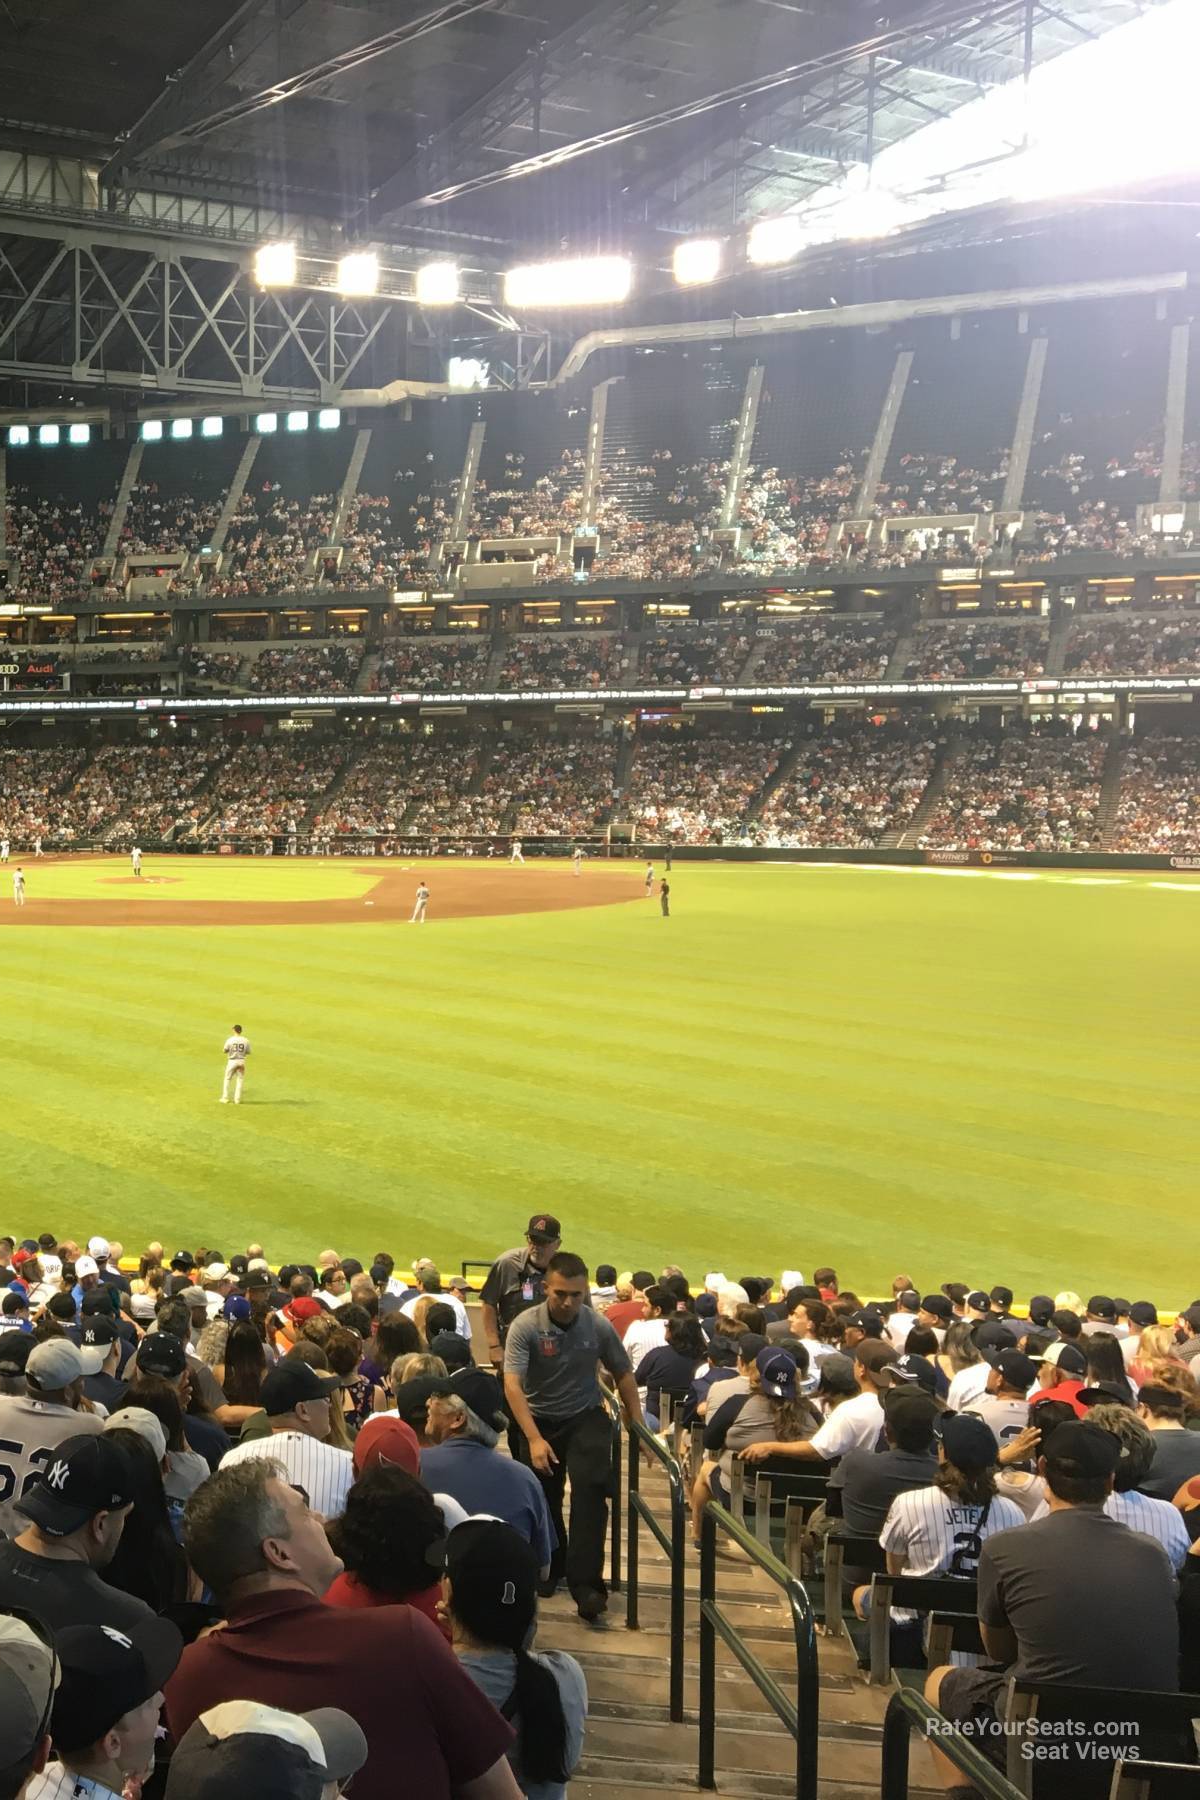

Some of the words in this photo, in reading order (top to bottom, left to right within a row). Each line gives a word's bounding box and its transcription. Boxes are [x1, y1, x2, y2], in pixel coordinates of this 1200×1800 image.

[27, 664, 53, 673] Audi
[231, 1043, 245, 1053] 39
[48, 1459, 70, 1490] NY
[950, 1532, 982, 1576] 2
